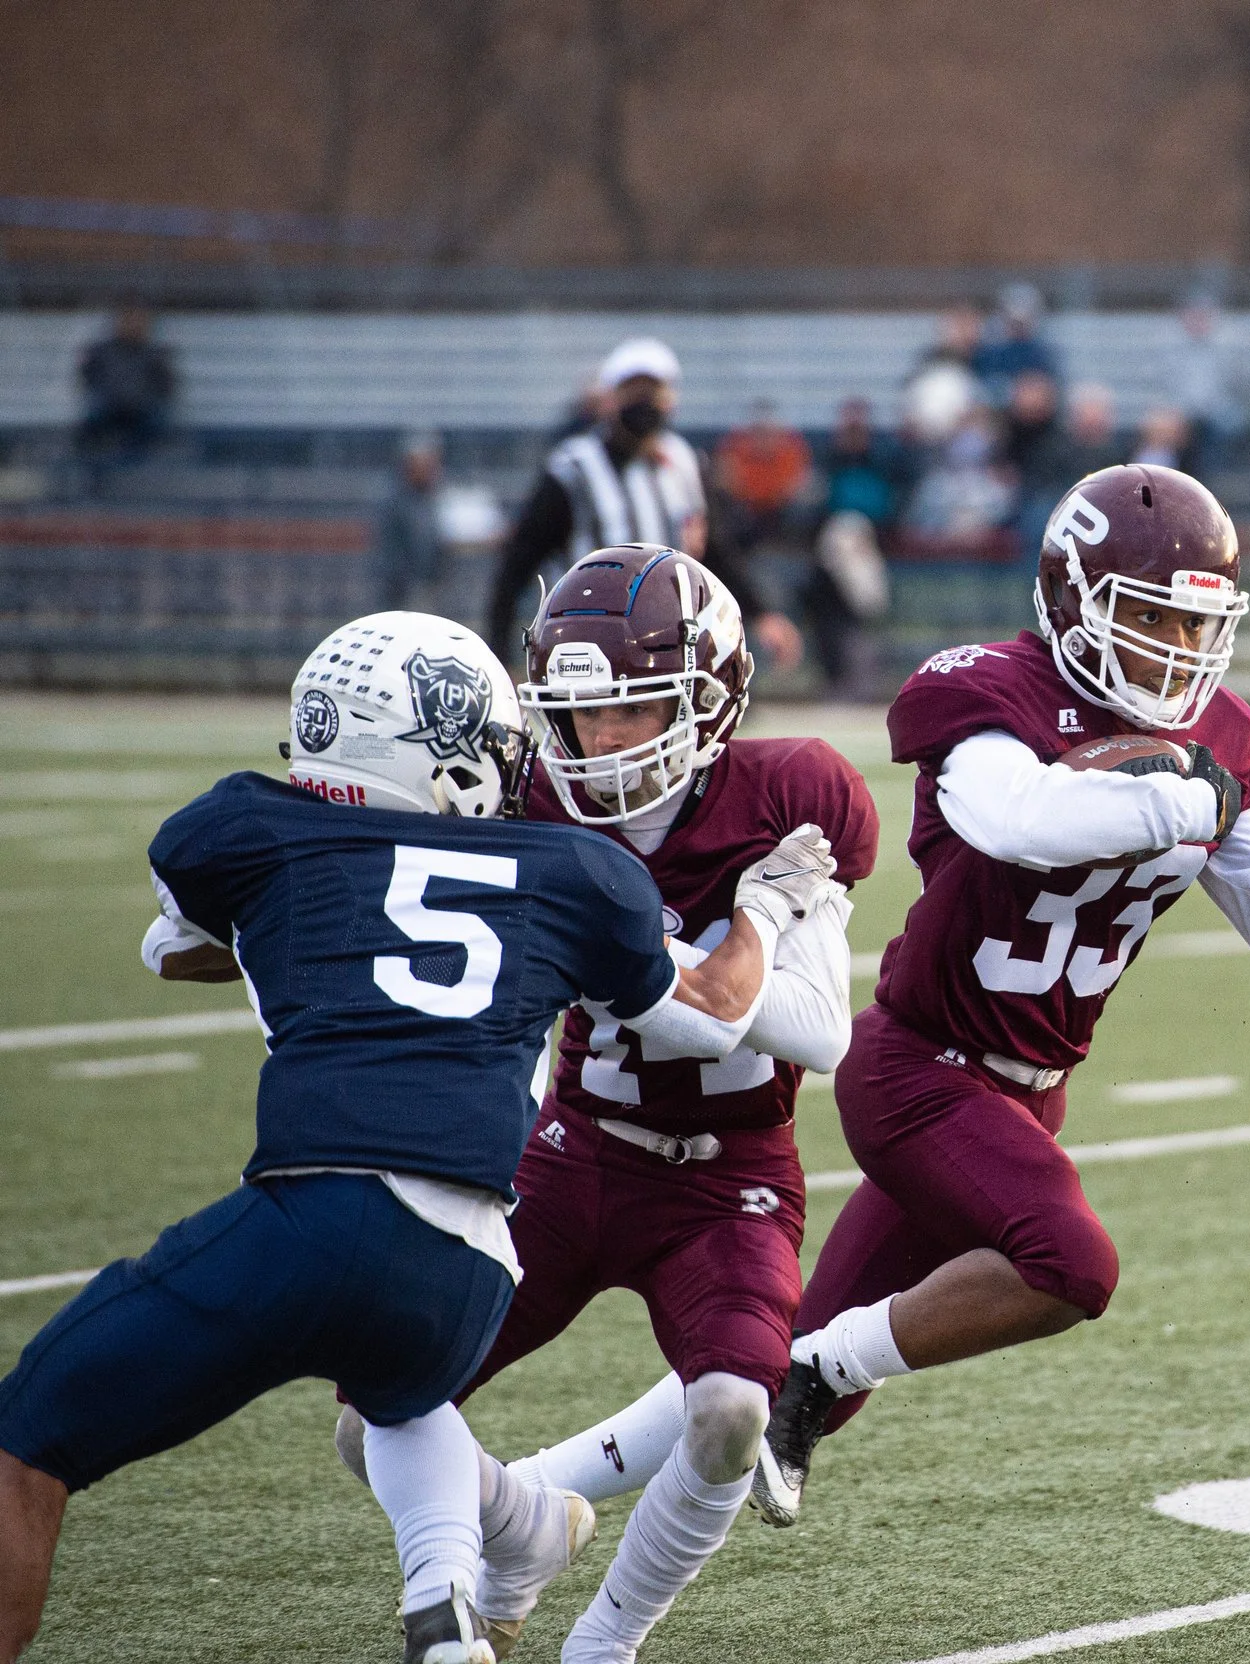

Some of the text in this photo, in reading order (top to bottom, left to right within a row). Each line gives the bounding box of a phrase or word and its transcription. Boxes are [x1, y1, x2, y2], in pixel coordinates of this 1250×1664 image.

[1050, 490, 1109, 551] P
[1188, 574, 1221, 590] Riddell
[559, 661, 591, 673] schutt
[448, 683, 463, 706] P
[303, 706, 328, 726] 50
[373, 844, 518, 1019] 5
[972, 843, 1208, 998] 33
